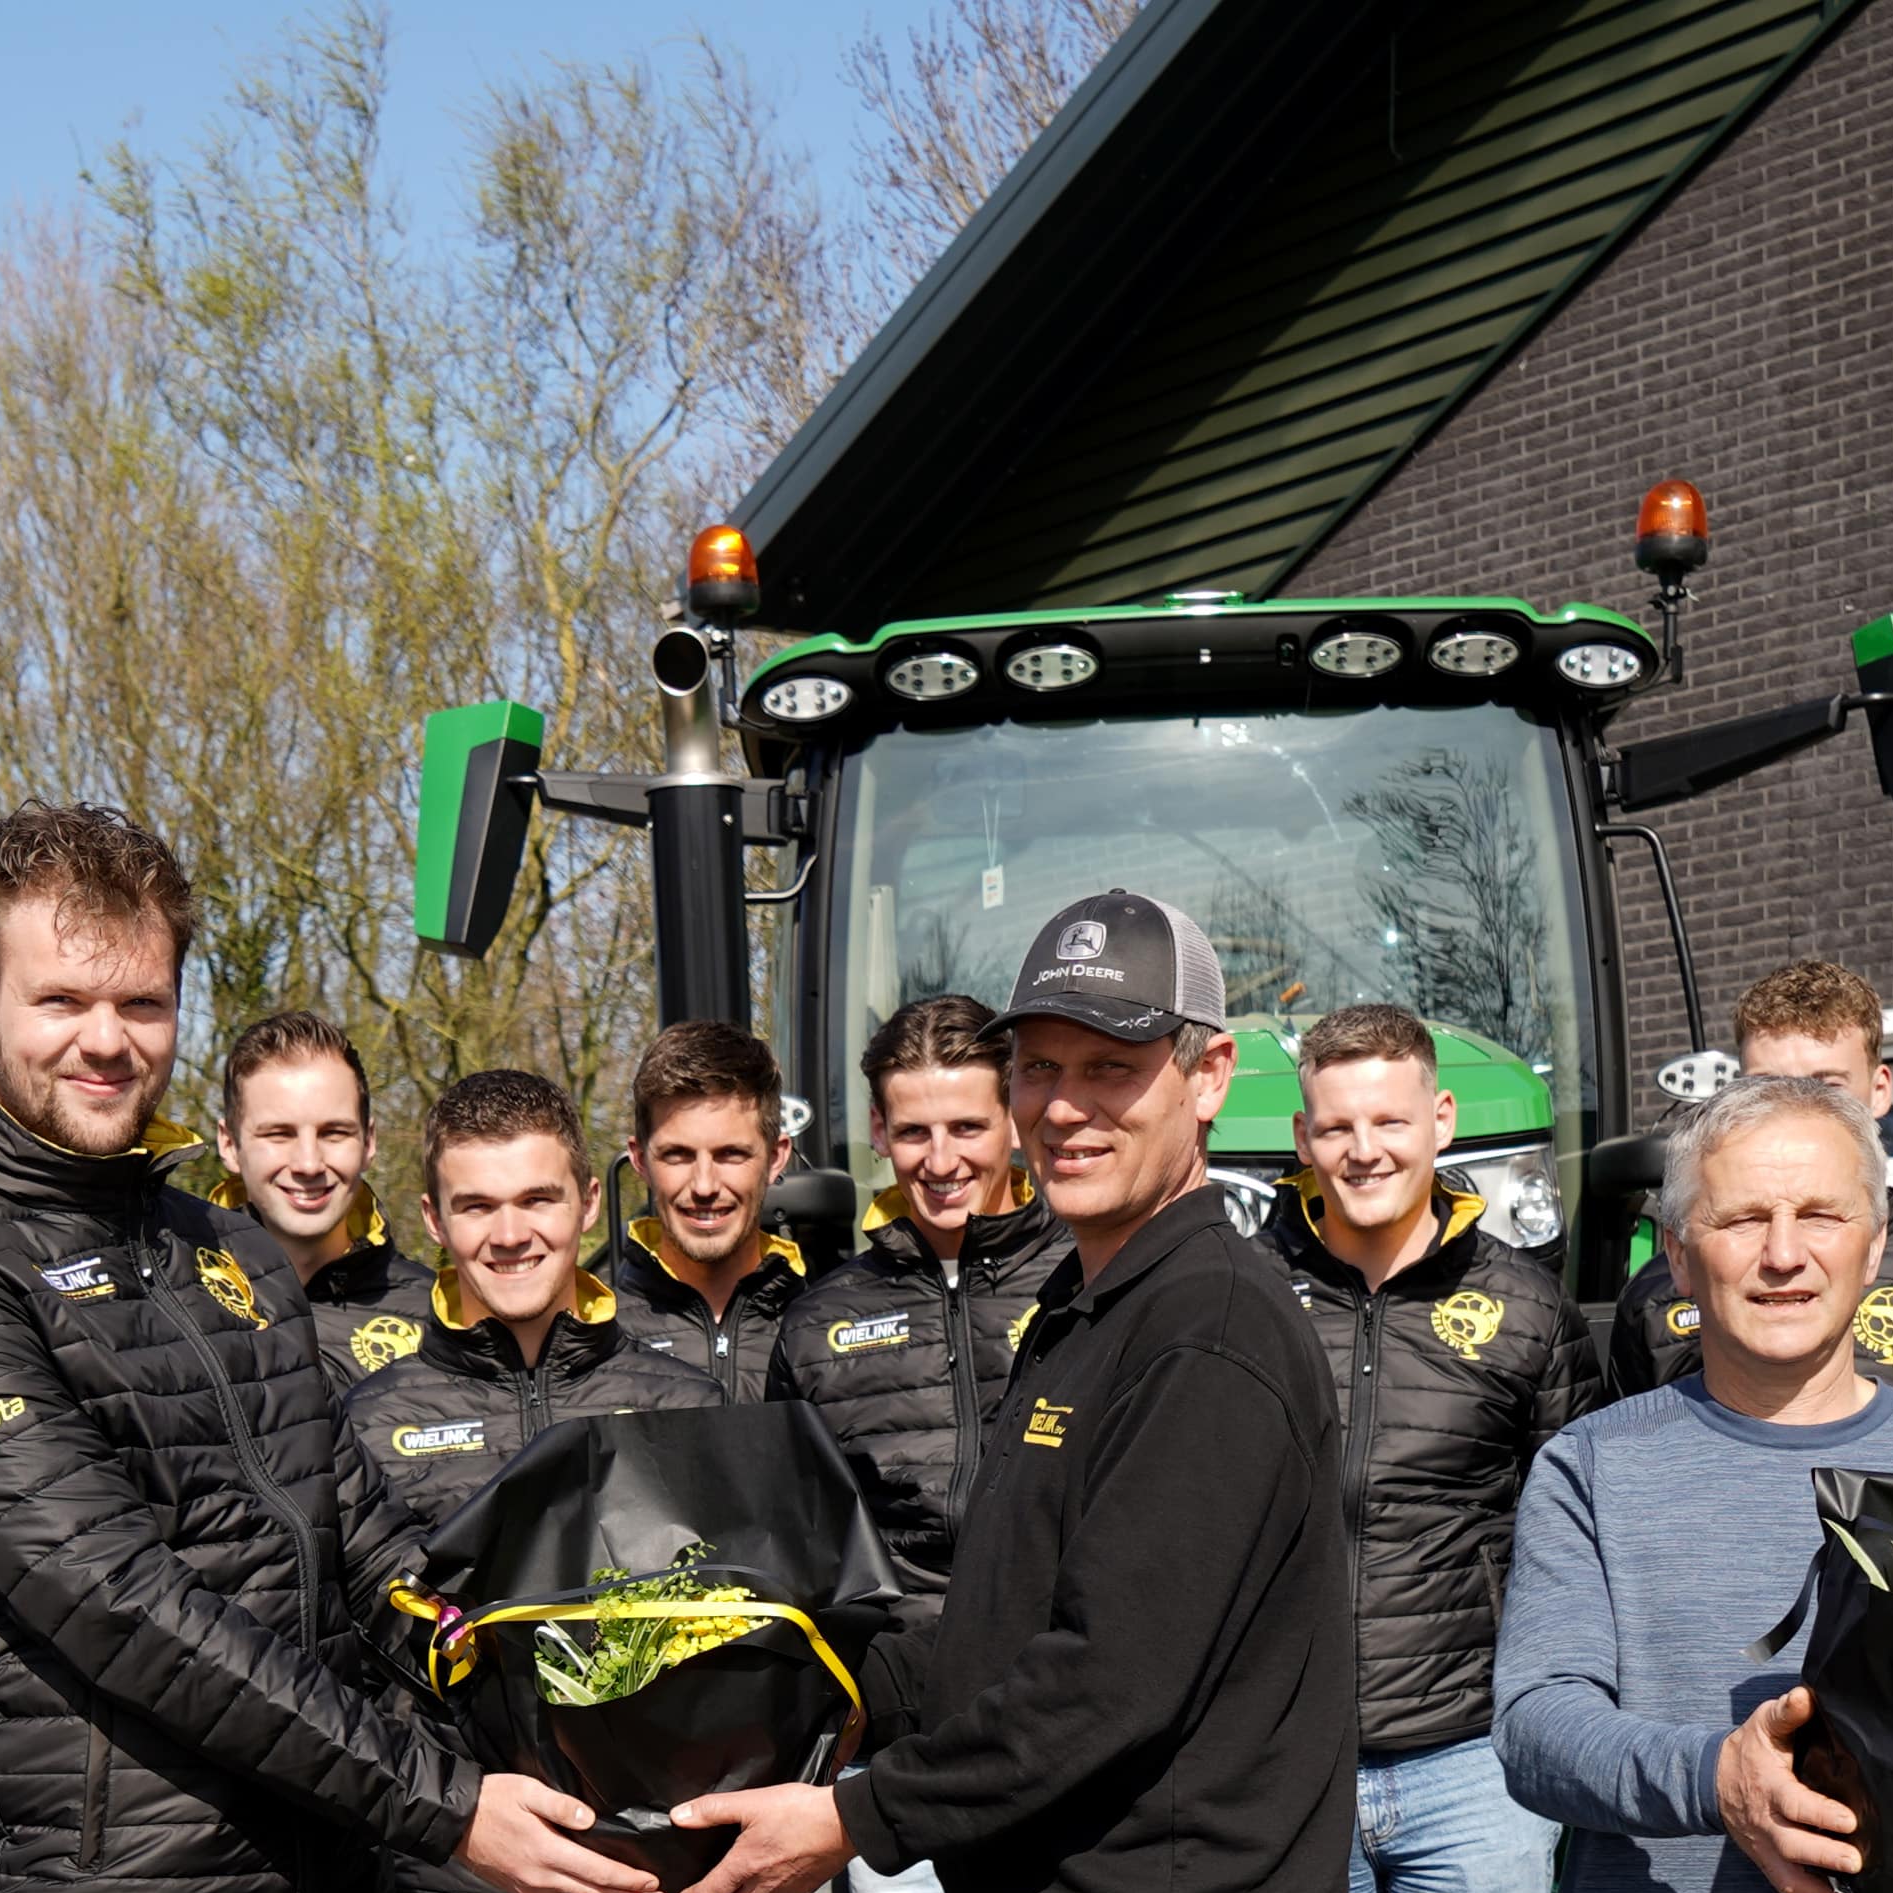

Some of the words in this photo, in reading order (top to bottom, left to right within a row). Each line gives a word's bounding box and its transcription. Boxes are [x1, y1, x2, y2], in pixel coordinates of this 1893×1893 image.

[1032, 966, 1070, 986] JOHN
[1071, 964, 1125, 982] DEERE
[838, 1321, 898, 1345] WIELINK
[404, 1428, 472, 1449] WIELINK
